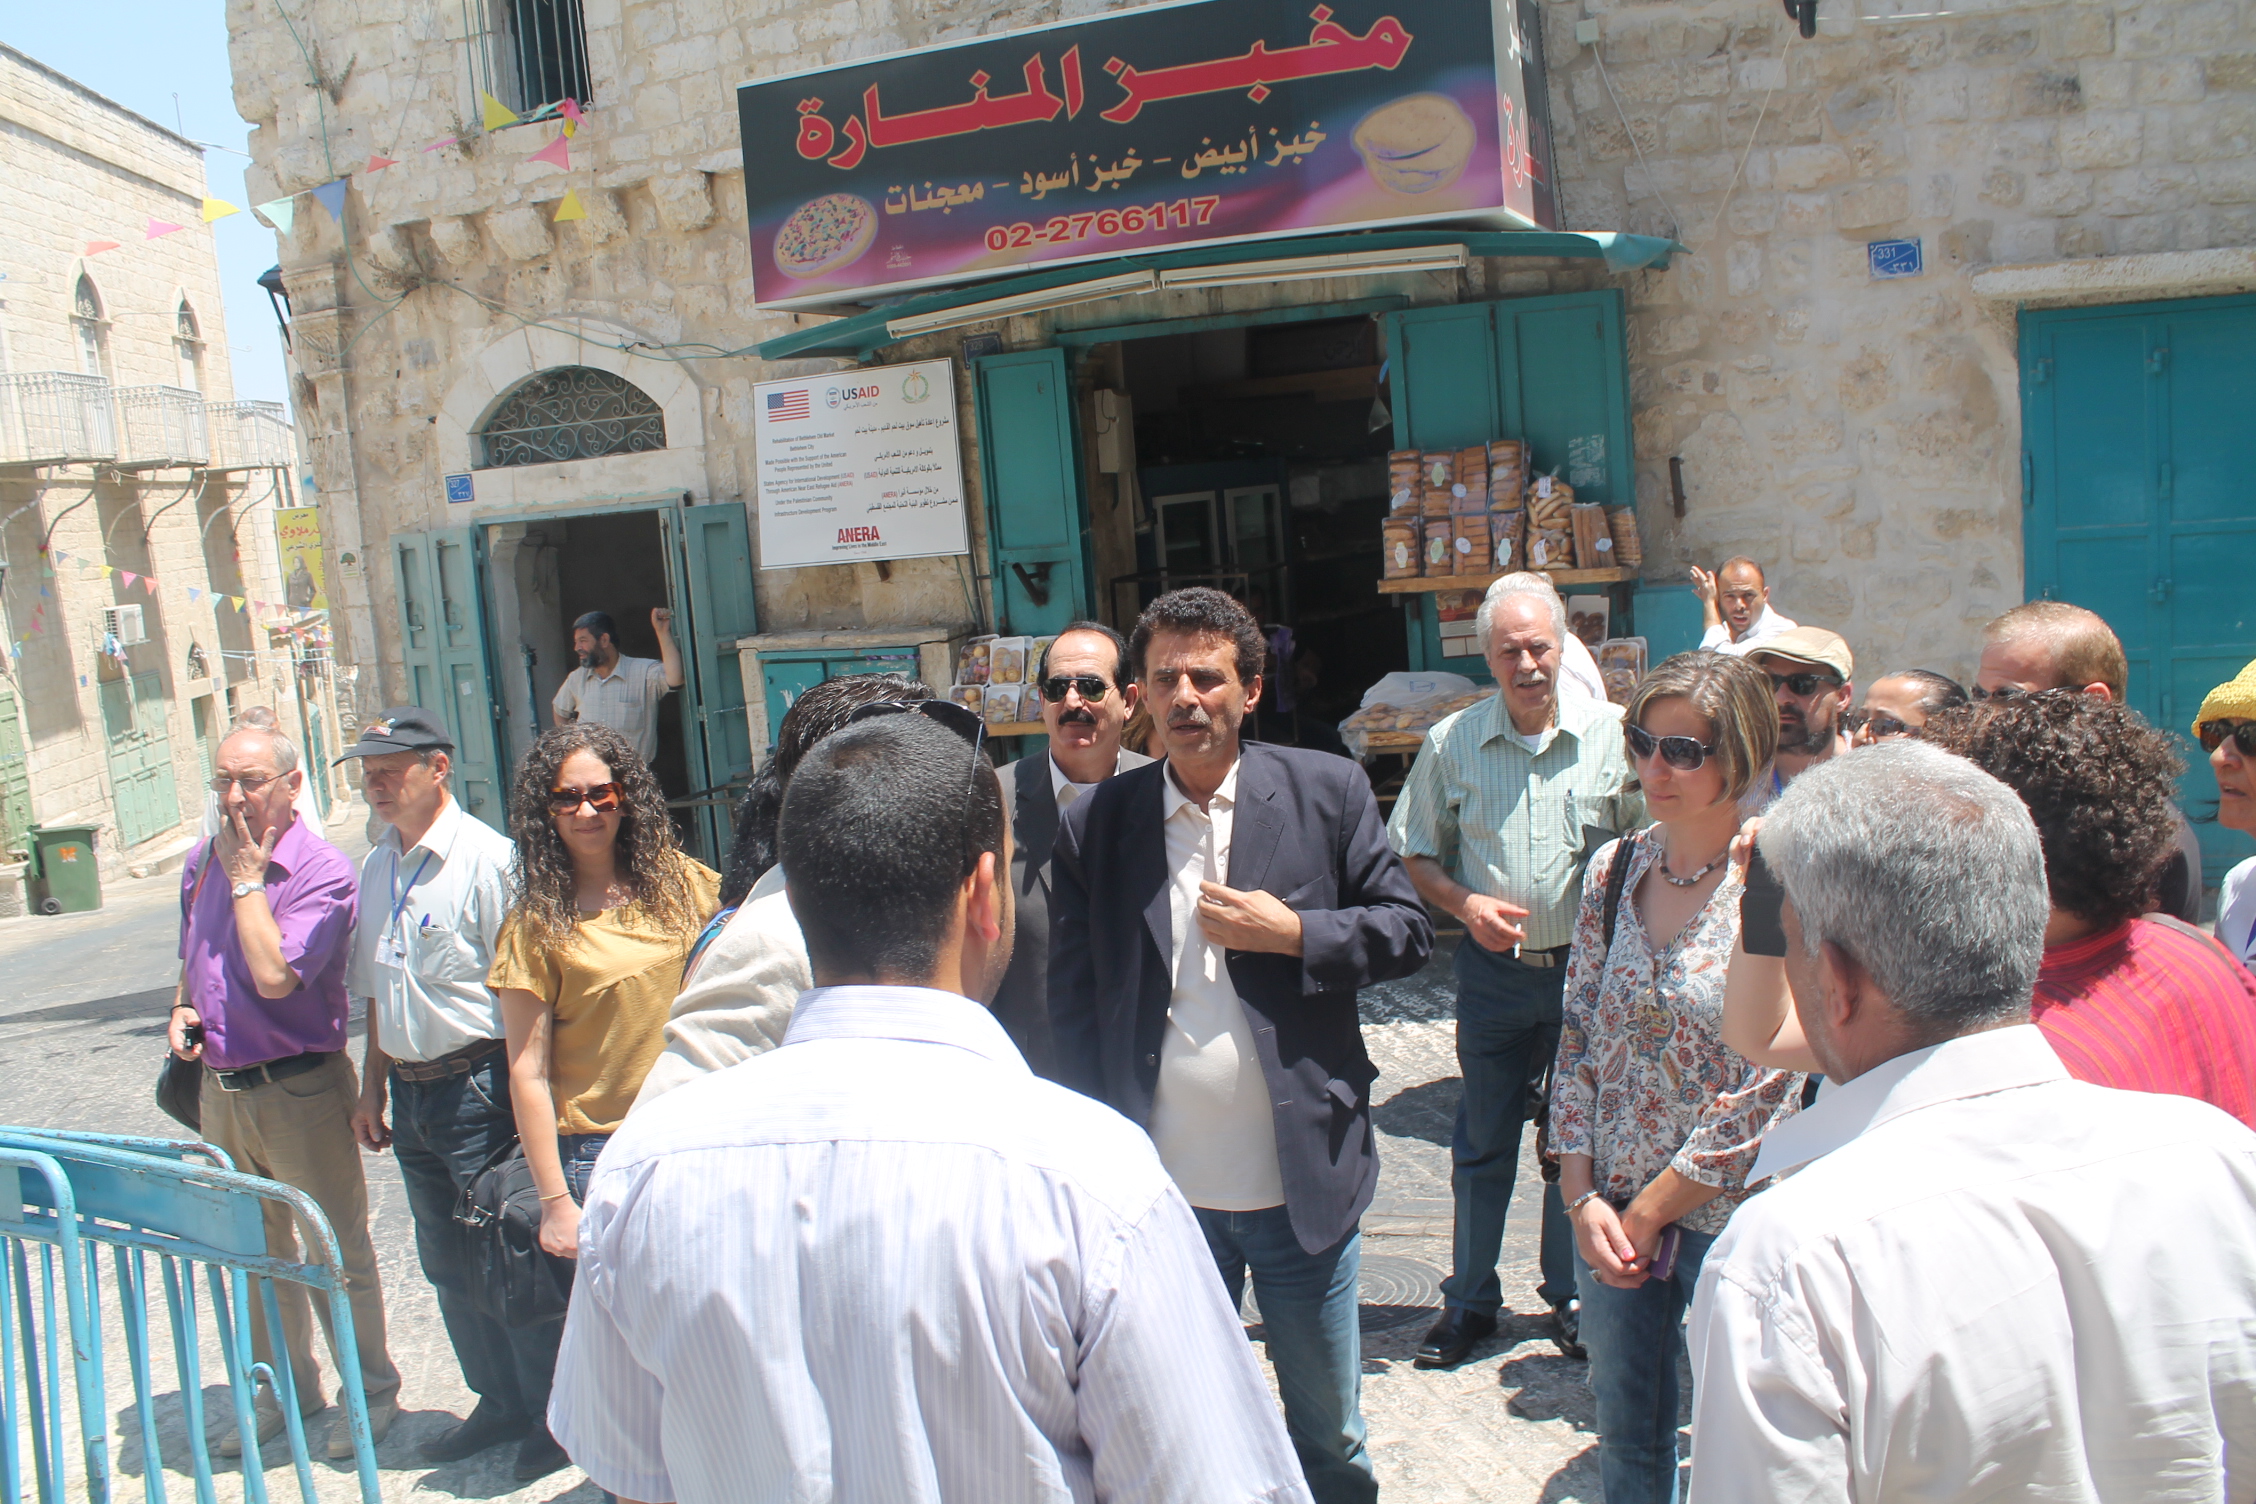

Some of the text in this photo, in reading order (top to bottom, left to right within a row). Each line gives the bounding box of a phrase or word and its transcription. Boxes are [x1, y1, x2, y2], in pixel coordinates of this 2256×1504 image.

[796, 3, 1414, 170] مخبز المنارة
[1265, 120, 1327, 167] خبز
[1181, 125, 1259, 179] أبيض
[1020, 152, 1080, 200] أسود
[1085, 147, 1143, 193] خبز
[884, 181, 985, 215] معجنات
[984, 195, 1220, 254] 02-2766117
[1878, 247, 1896, 259] 331
[969, 341, 984, 351] 329
[842, 385, 880, 400] USAID
[906, 421, 915, 431] سوق
[935, 416, 949, 428] مشروع
[805, 454, 819, 462] Support
[787, 463, 809, 472] Represented
[775, 479, 788, 487] Agency
[817, 474, 840, 482] Development
[840, 472, 855, 480] (USAID)
[864, 470, 878, 480] (USAID)
[815, 482, 830, 490] Refugee
[837, 481, 854, 489] (ANERA)
[792, 496, 812, 504] Palestinian
[881, 491, 898, 500] (ANERA)
[774, 509, 798, 517] Infrastructure
[798, 507, 821, 516] Development
[837, 525, 880, 543] ANERA
